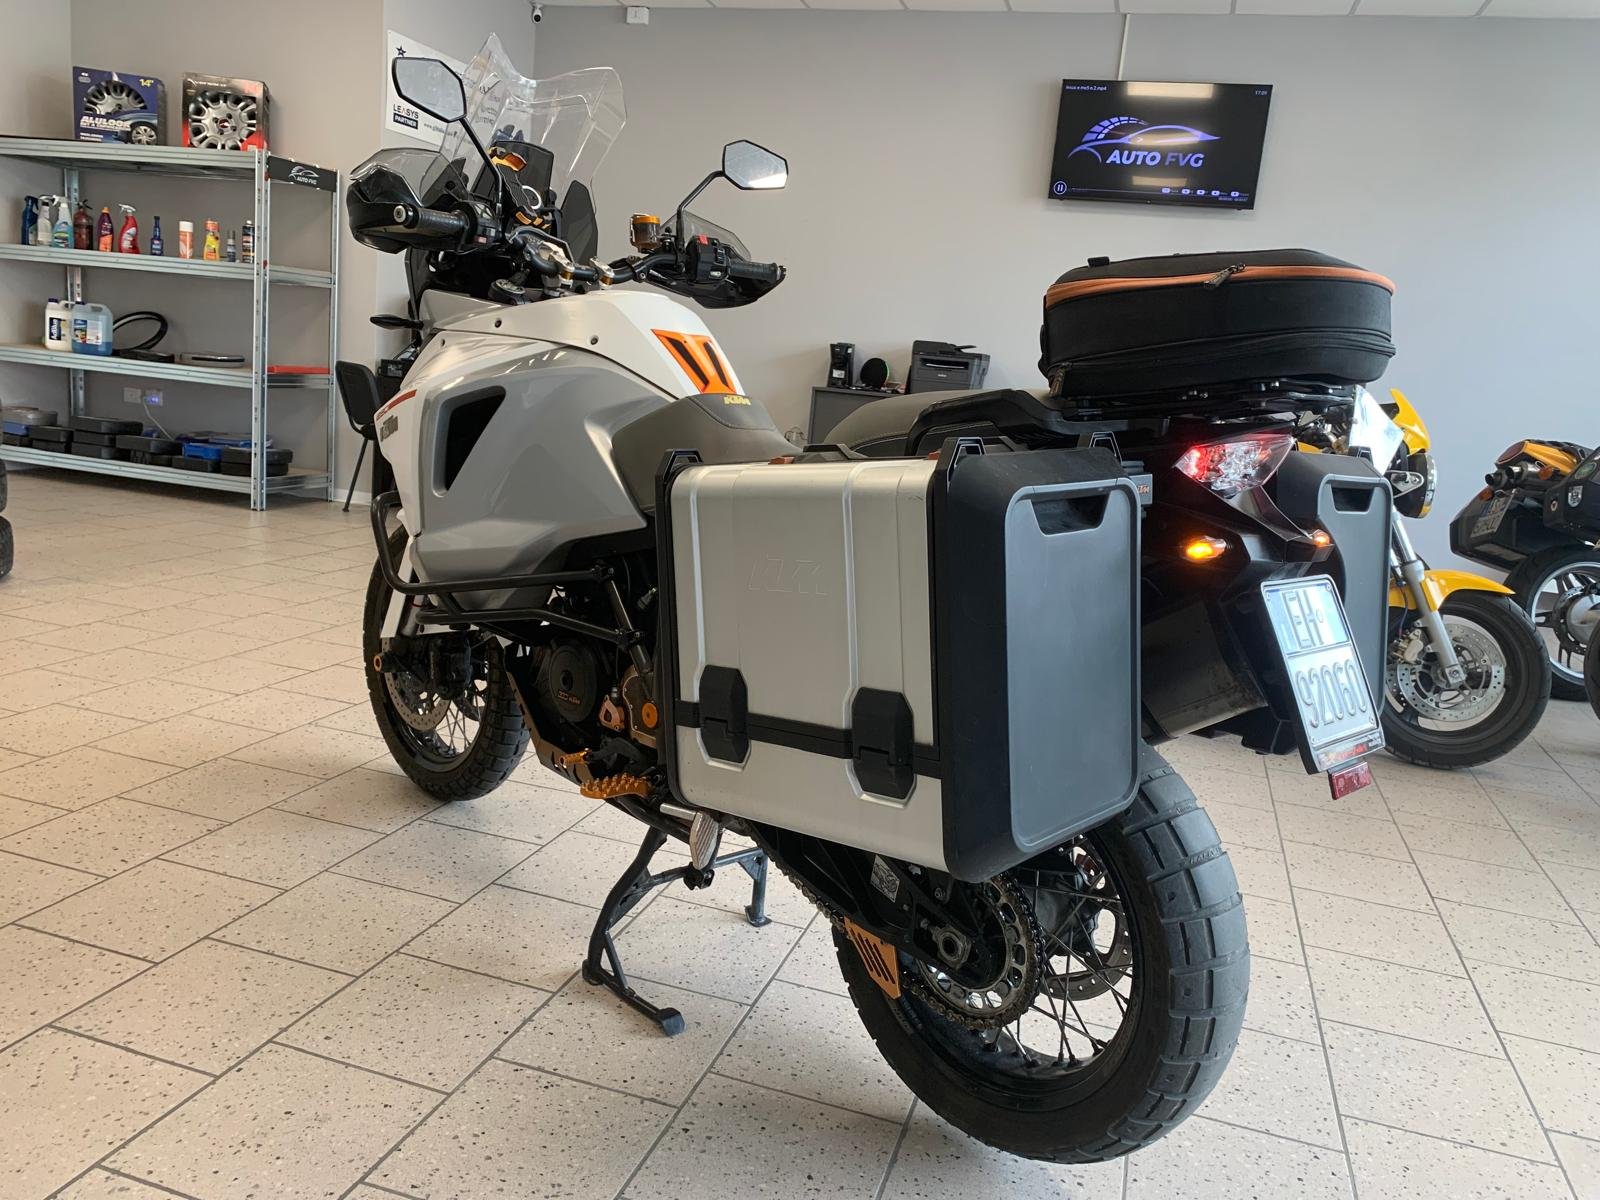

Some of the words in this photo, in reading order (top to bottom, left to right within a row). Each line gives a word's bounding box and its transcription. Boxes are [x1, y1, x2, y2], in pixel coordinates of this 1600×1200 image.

[394, 114, 418, 127] PARTNER
[1106, 150, 1161, 166] AUTO
[1164, 153, 1205, 168] FVG
[724, 395, 752, 406] KTM
[1295, 659, 1367, 728] 92060
